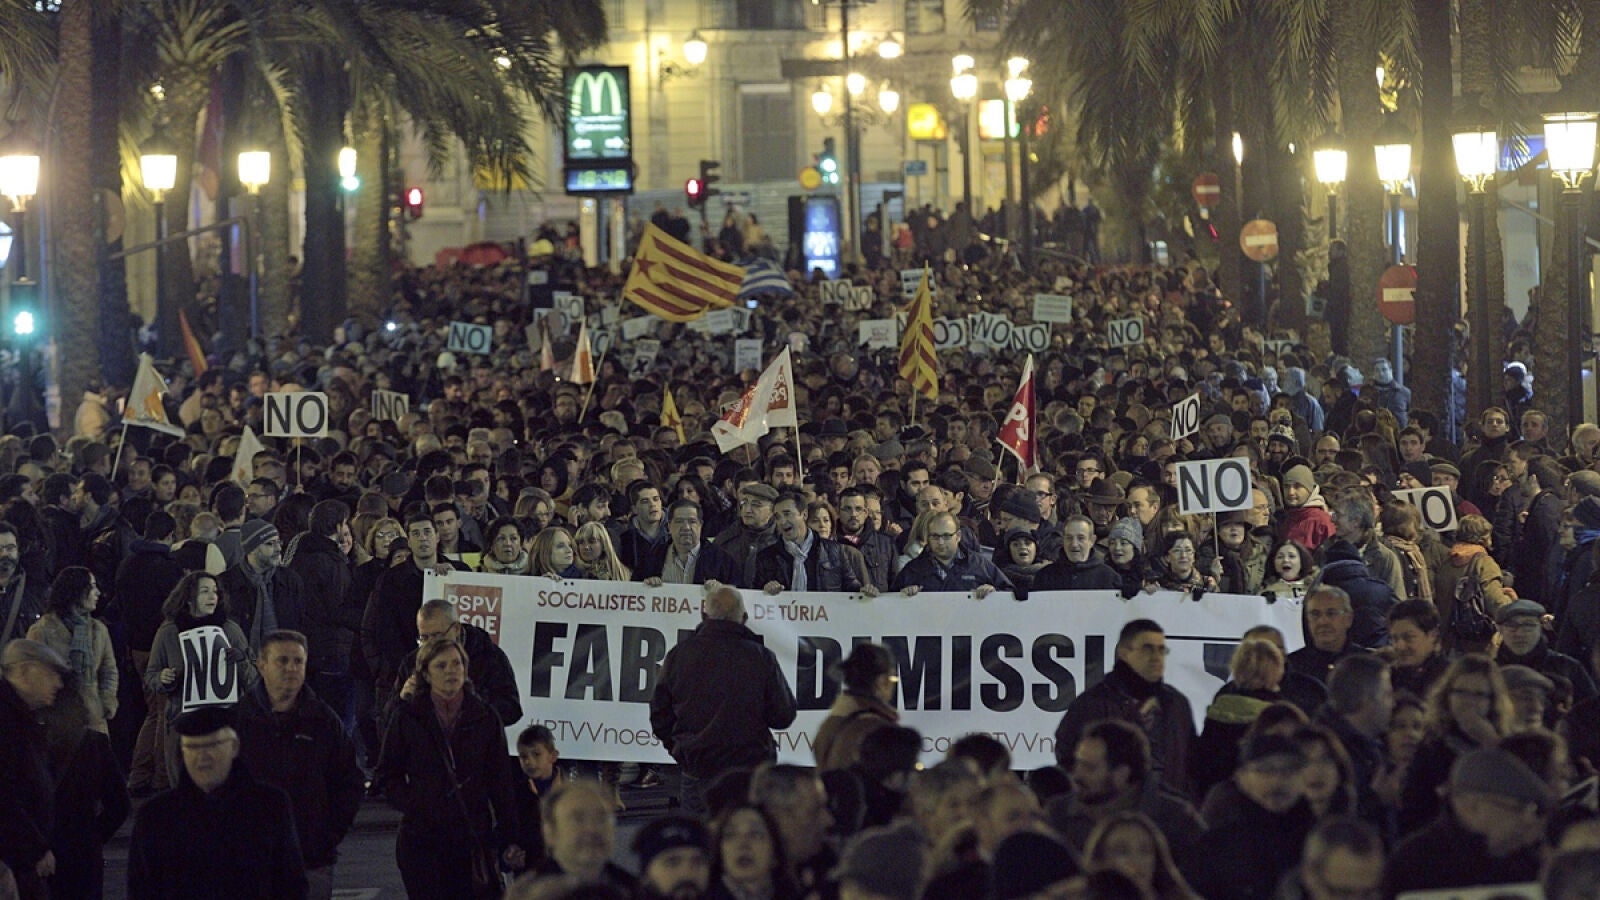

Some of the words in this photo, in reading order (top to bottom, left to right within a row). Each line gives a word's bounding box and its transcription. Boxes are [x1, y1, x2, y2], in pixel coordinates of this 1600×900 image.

[451, 324, 485, 350] NO
[1011, 326, 1046, 352] NO
[1110, 320, 1140, 345] NO
[267, 394, 325, 435] NO
[1172, 398, 1198, 440] NO
[1179, 461, 1249, 511] NO
[1407, 489, 1453, 530] O
[537, 590, 646, 612] SOCIALISTES
[651, 596, 707, 614] RIBA-
[754, 603, 776, 620] DE
[778, 600, 829, 622] TÚRIA
[459, 614, 497, 635] SOE
[183, 634, 237, 702] NO
